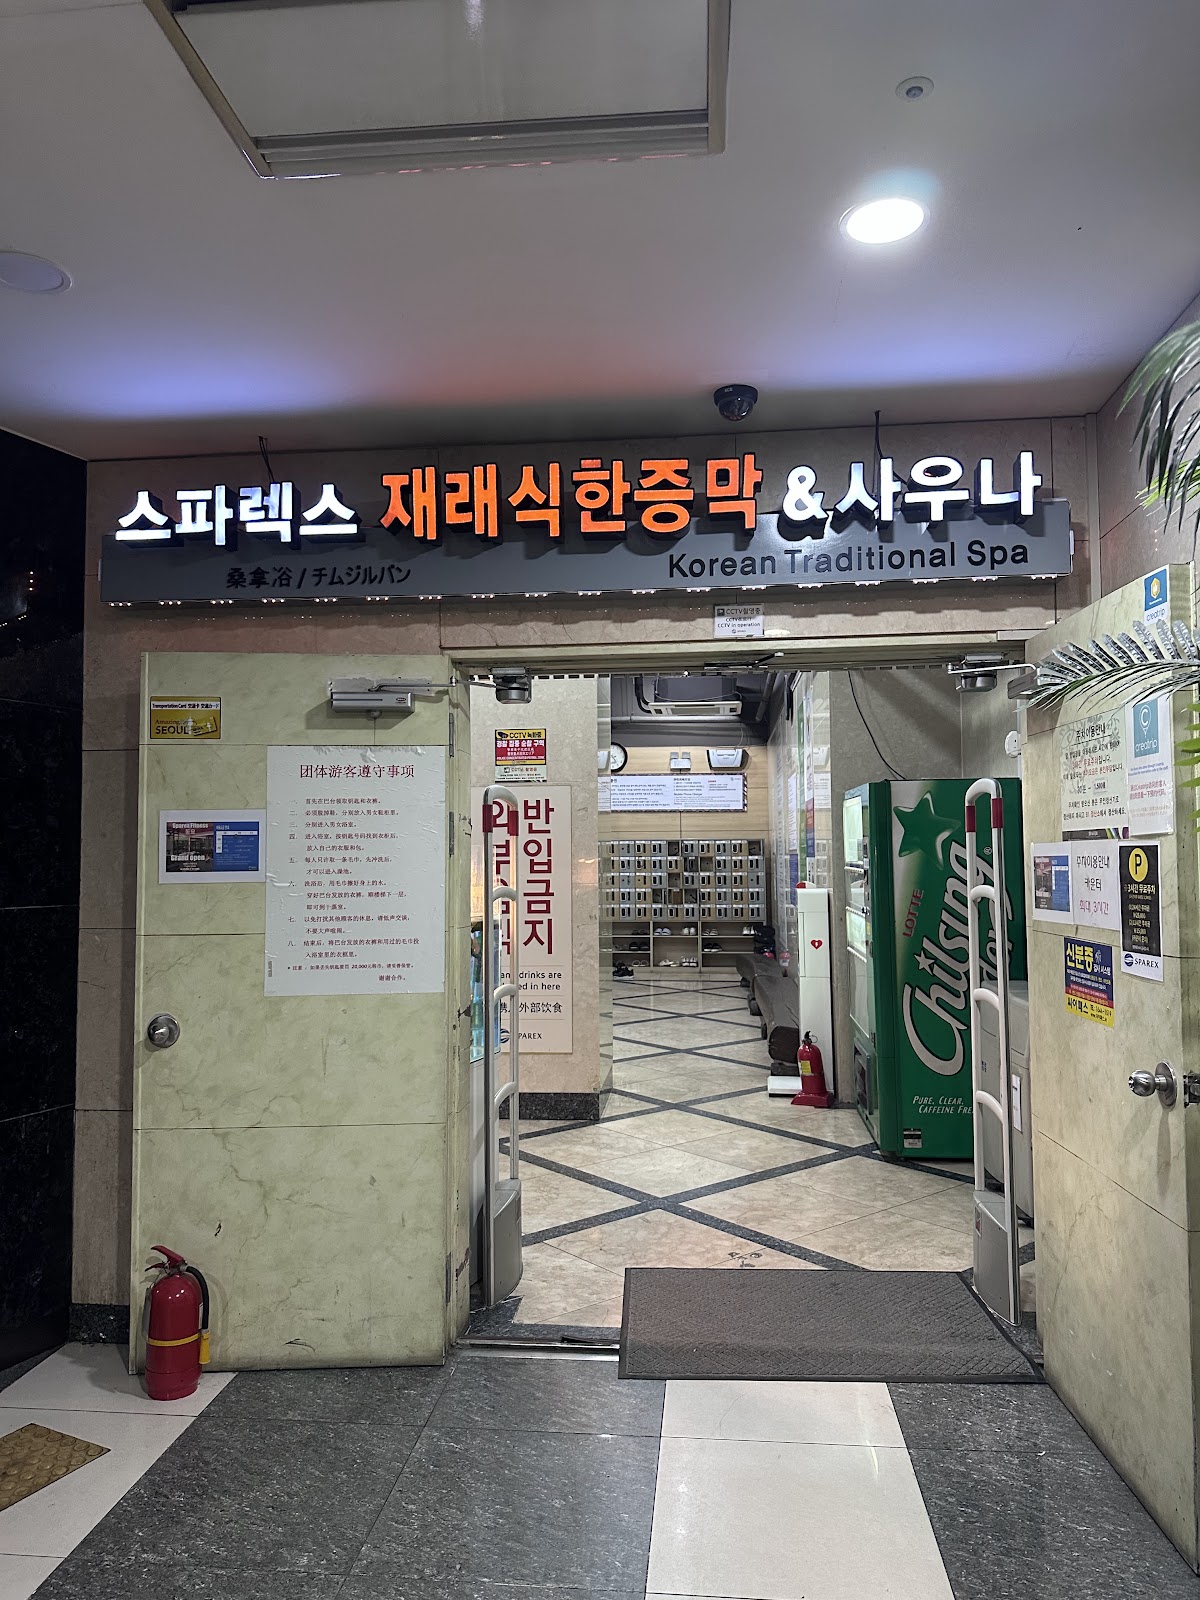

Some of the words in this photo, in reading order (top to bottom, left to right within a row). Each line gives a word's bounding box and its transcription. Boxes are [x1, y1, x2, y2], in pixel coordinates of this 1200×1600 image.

[114, 482, 358, 546] 스파렉스
[669, 551, 776, 578] Korean
[784, 541, 956, 575] Traditional
[967, 539, 1029, 570] Spa
[1146, 608, 1165, 622] creatrip
[155, 725, 189, 735] SEOUL
[1135, 738, 1158, 753] creatrip
[300, 764, 415, 778] 团体游客遵守事项
[1134, 854, 1142, 875] P
[523, 798, 555, 955] 반입금지
[903, 888, 924, 938] LOTTE
[1066, 942, 1094, 973] 신분증
[1134, 957, 1159, 969] SPAREX
[518, 971, 546, 979] drinks
[912, 1095, 935, 1105] PURE.
[938, 1095, 964, 1105] CLEAR.
[918, 1104, 955, 1114] CAFFEINE
[957, 1105, 974, 1114] FRE
